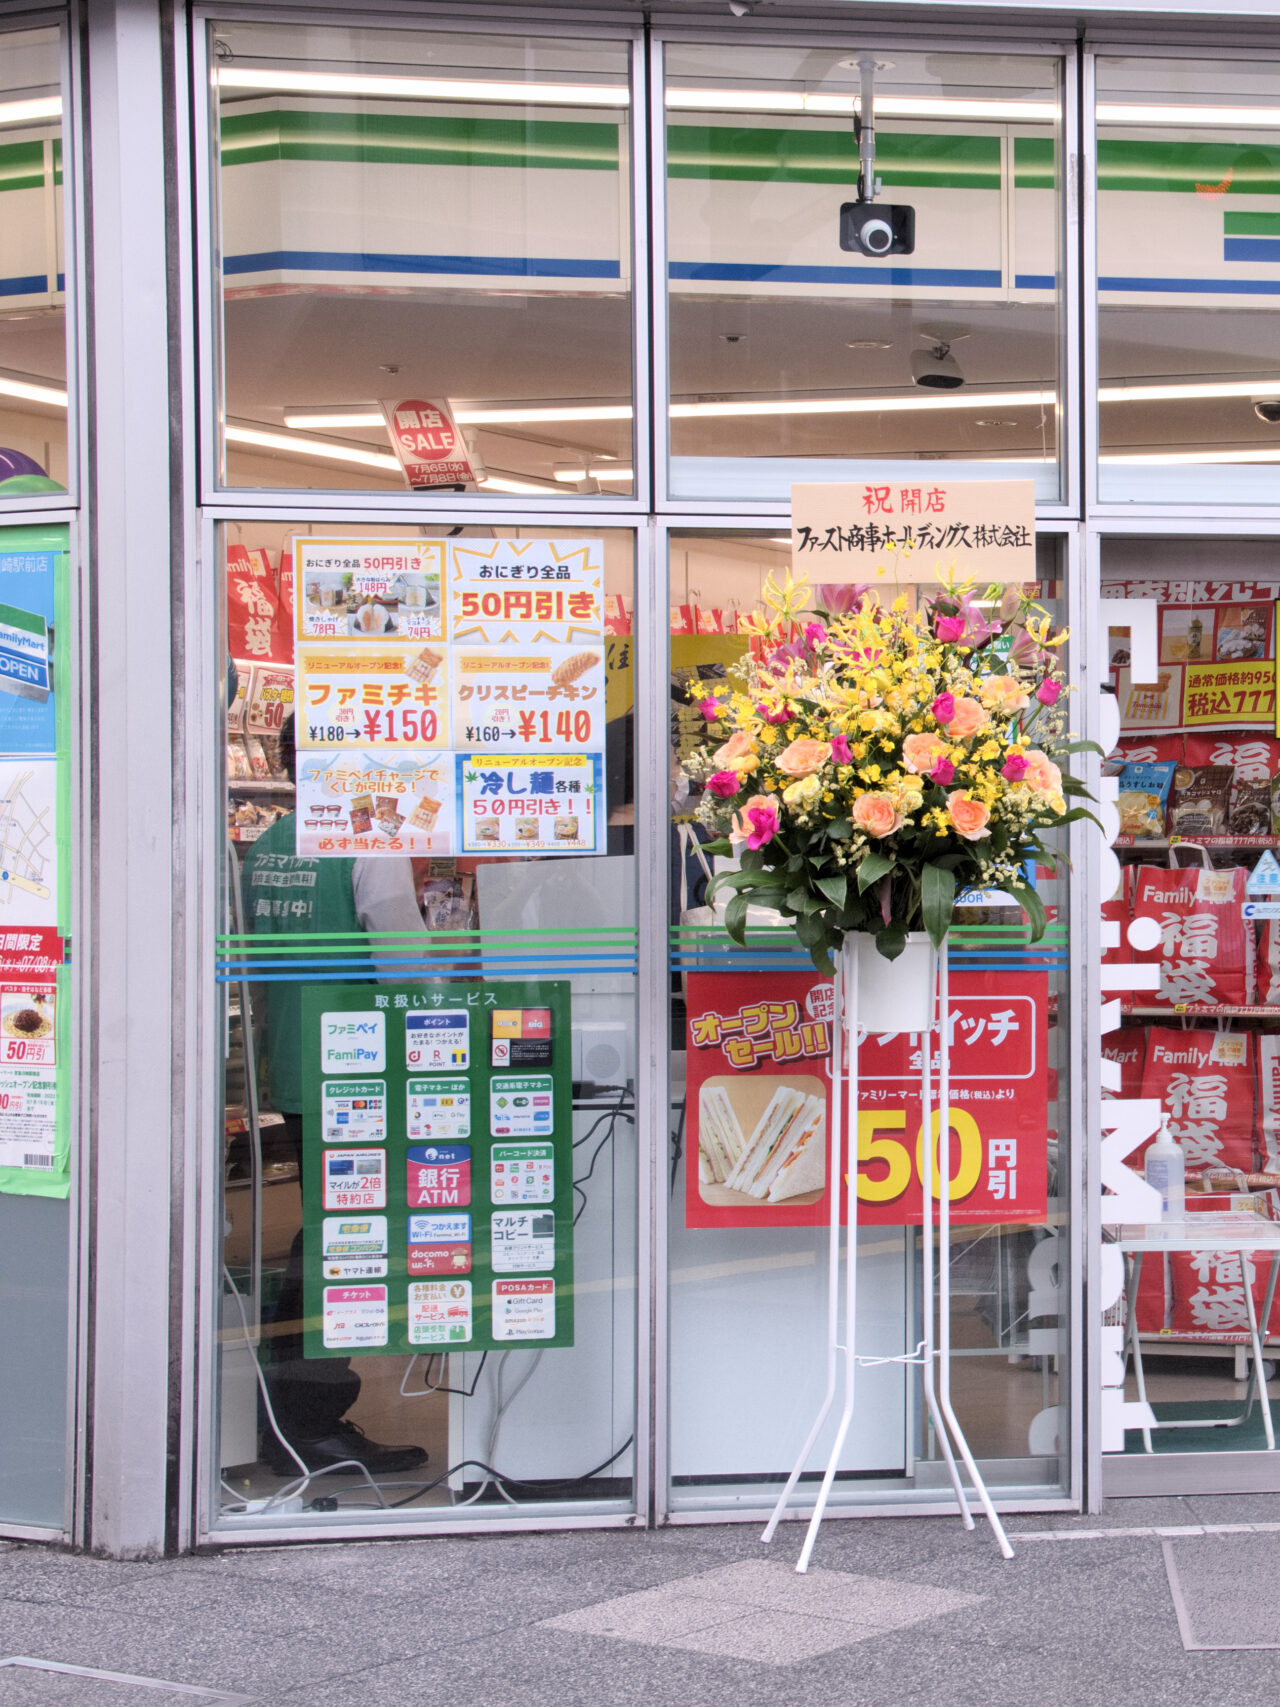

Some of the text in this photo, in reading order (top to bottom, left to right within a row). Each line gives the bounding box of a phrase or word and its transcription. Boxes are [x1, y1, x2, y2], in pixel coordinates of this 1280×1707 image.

[396, 410, 443, 429] 開店
[400, 432, 455, 451] SALE
[862, 486, 947, 515] 祝開店
[306, 557, 422, 571] おにぎり全品 50円引き
[479, 565, 571, 580] おにぎり全品
[359, 582, 387, 593] 148円
[461, 590, 595, 621] 50円引き
[312, 623, 336, 635] 78円
[408, 626, 431, 638] 74円
[0, 656, 39, 681] OPEN
[307, 683, 438, 707] ファミチキ
[458, 684, 597, 701] クリスピーチキン
[309, 709, 438, 743] ¥180 ¥150
[465, 709, 591, 743] ¥160 ¥140
[476, 757, 583, 767] リニューアルオープン記念
[308, 769, 440, 782] ファミペイチャージで
[330, 781, 416, 793] くじが引ける！
[480, 771, 581, 795] 冷し麺 各種
[374, 991, 499, 1010] 取扱いサービス
[423, 1017, 452, 1027] ポイント
[691, 1000, 799, 1045] オープン
[328, 1023, 379, 1036] ファミペイ
[410, 1031, 464, 1040] お好きなポイントが
[724, 1020, 830, 1068] セール!!
[327, 1048, 378, 1062] FamiPay
[328, 1085, 382, 1094] クレジットカード
[1165, 1072, 1228, 1168] 福袋
[845, 1106, 983, 1202] 50
[987, 1138, 1018, 1200] 円引
[329, 1176, 382, 1190] マイルが2倍
[417, 1168, 460, 1188] 銀行
[336, 1193, 375, 1206] 特約店
[417, 1189, 458, 1204] ATM
[431, 1222, 468, 1231] つかえます
[493, 1216, 529, 1228] マルチ
[411, 1231, 433, 1239] Wi-Fi
[493, 1229, 529, 1241] コピー
[411, 1249, 449, 1259] docomo
[344, 1266, 382, 1275] ヤマト運輸
[501, 1283, 549, 1292] POSAカード
[342, 1290, 372, 1300] チケット
[414, 1312, 446, 1321] サービス
[413, 1333, 446, 1342] サービス
